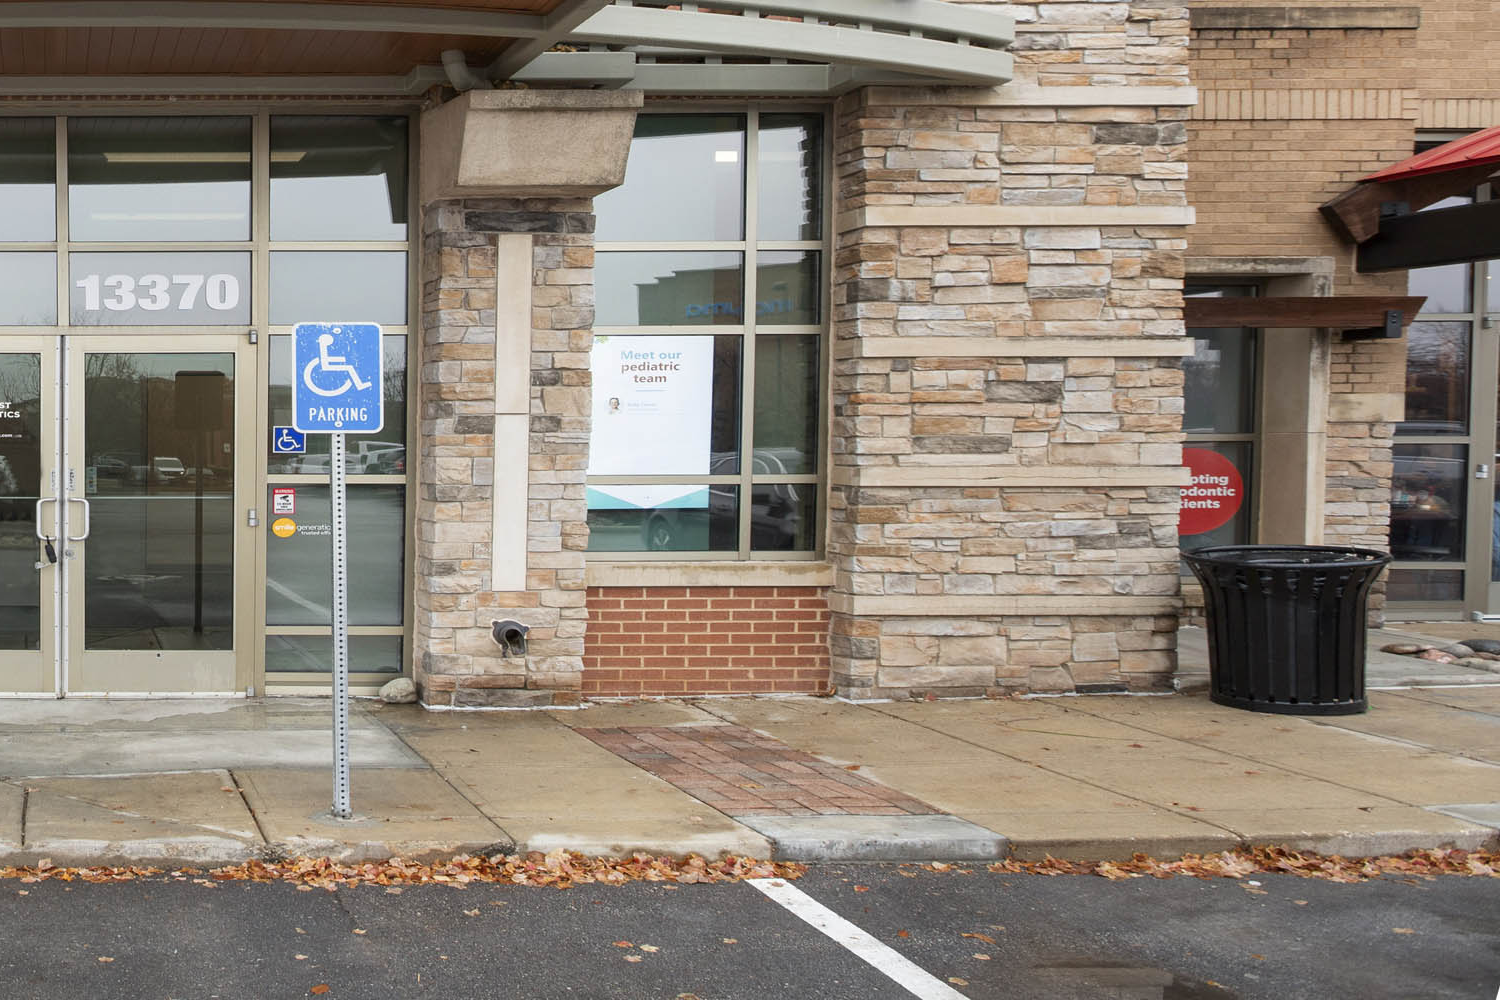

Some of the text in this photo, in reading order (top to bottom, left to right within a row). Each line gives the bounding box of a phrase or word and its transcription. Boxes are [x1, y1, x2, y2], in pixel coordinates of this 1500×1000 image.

[75, 273, 240, 311] 13370
[620, 351, 682, 360] Meet our
[621, 361, 681, 374] pediatric
[633, 374, 667, 383] team
[308, 407, 369, 422] PARKING
[1190, 474, 1229, 486] pting
[1180, 486, 1236, 497] odontic
[1180, 498, 1221, 509] tients
